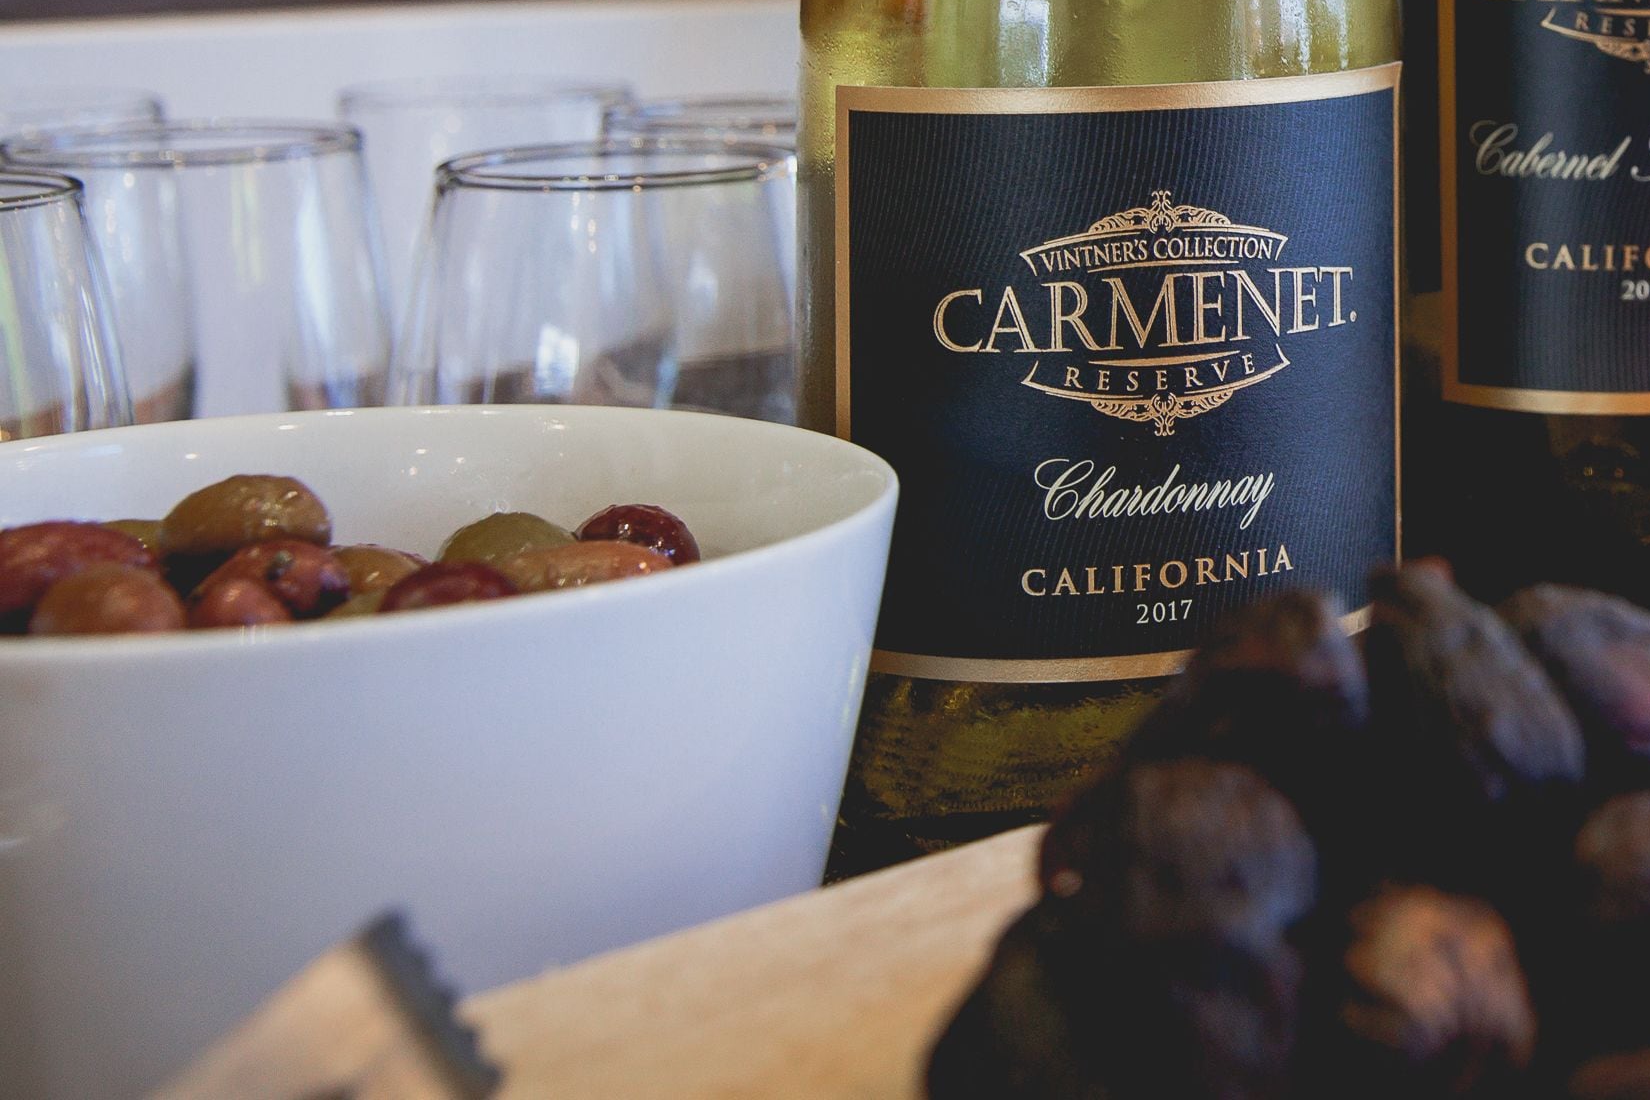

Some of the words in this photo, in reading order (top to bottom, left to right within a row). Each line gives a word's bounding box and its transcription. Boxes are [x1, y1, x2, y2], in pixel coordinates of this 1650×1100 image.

[1470, 120, 1632, 181] Cabernet
[1039, 238, 1149, 273] VINTNER'S
[1153, 234, 1273, 262] COLLECTION
[1065, 353, 1257, 392] RESERVE
[1034, 458, 1275, 530] Chardonnay
[1021, 544, 1294, 596] CALIFORNIA
[1136, 599, 1193, 625] 2017
